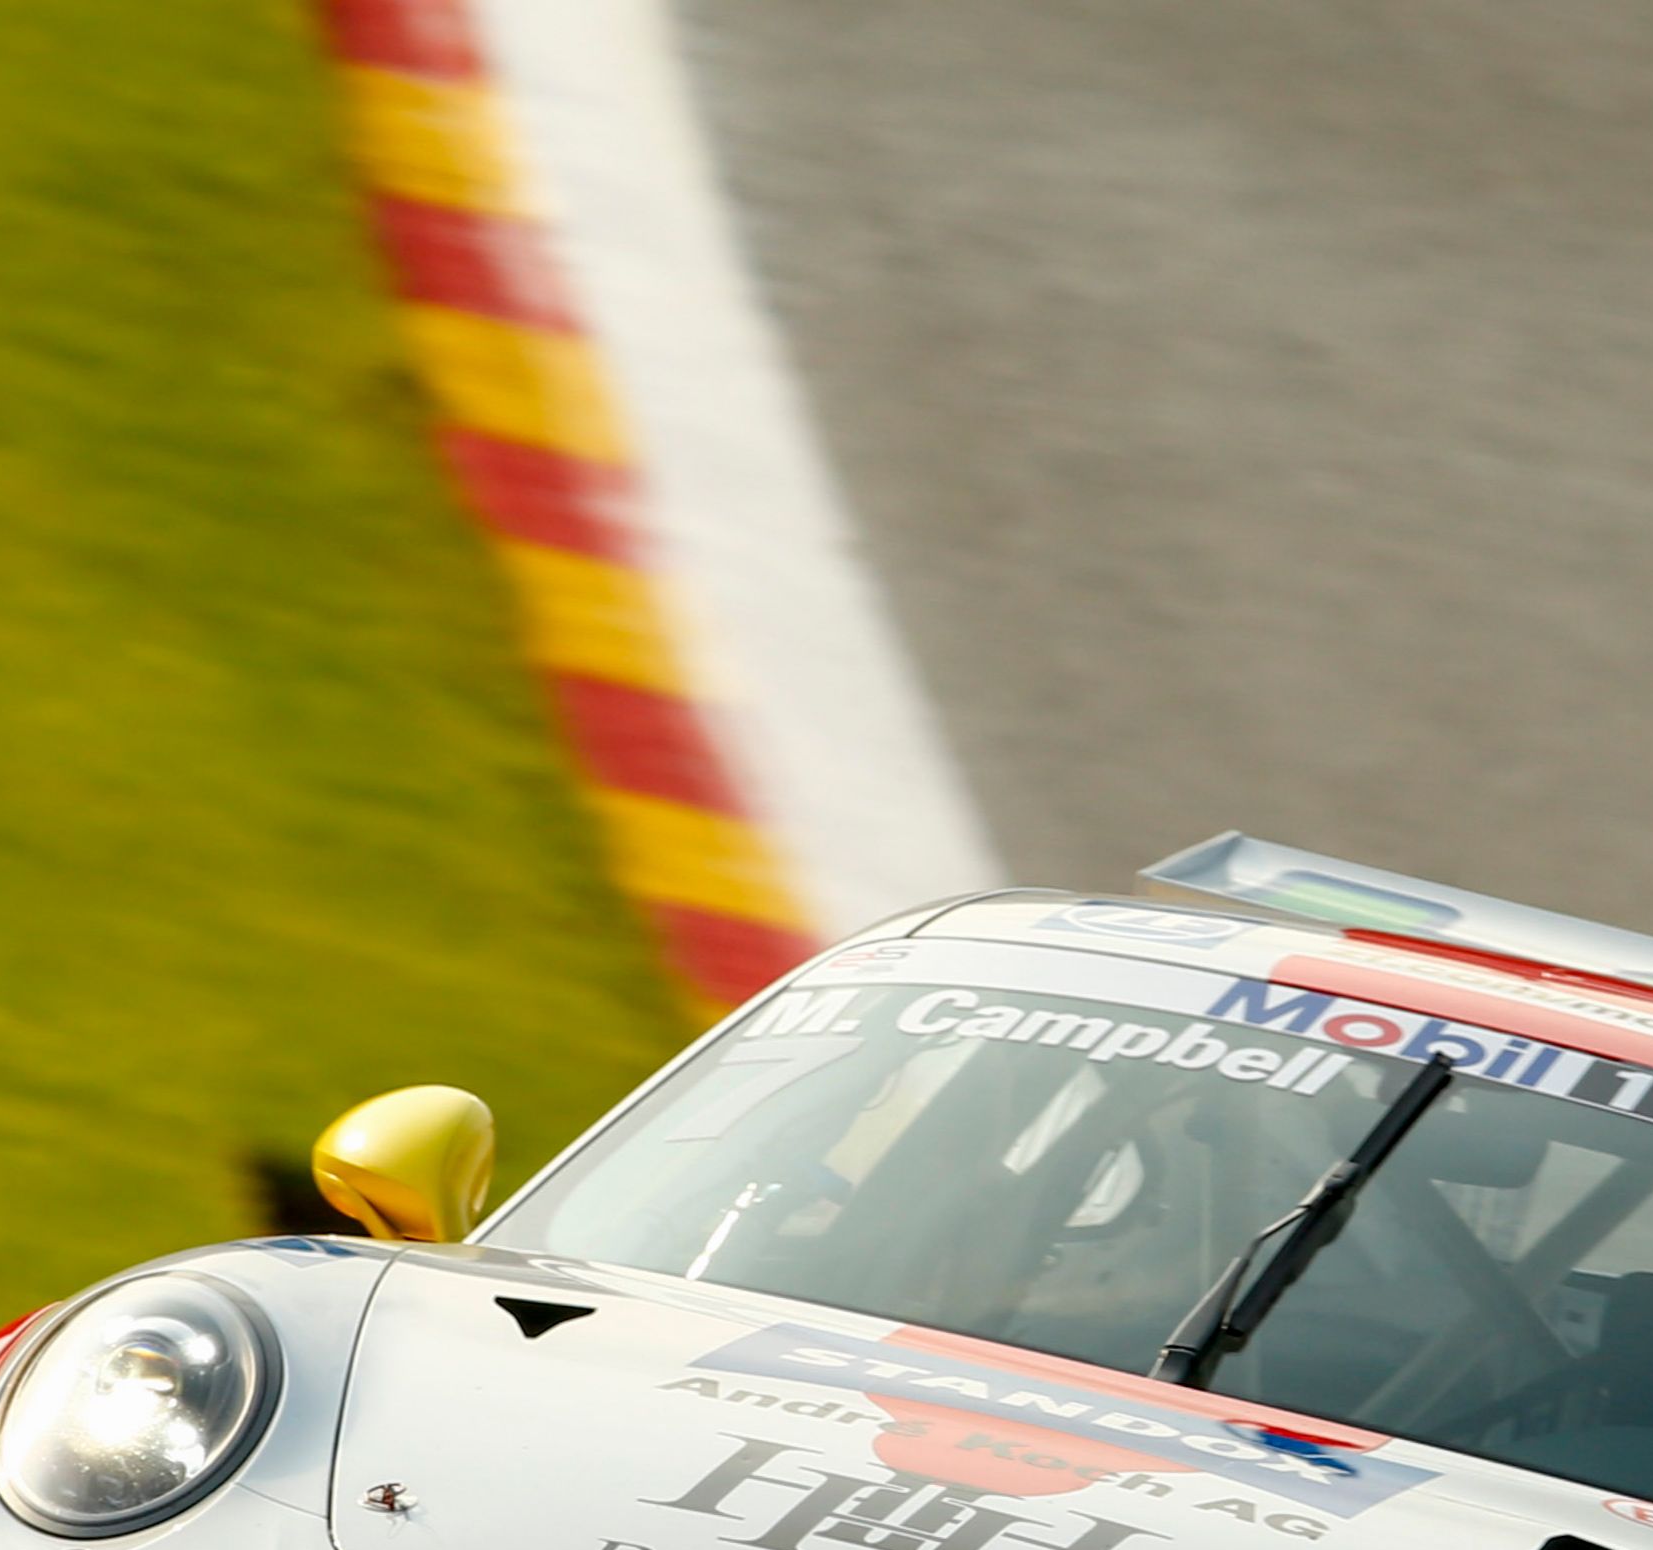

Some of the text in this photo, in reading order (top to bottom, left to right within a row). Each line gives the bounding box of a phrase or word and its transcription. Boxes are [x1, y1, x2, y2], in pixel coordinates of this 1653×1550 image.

[747, 989, 1354, 1097] M. Campbell
[1208, 978, 1563, 1088] Mobil
[778, 1346, 1342, 1485] STANDOX
[954, 1432, 1174, 1498] Koch
[1192, 1496, 1331, 1541] AG
